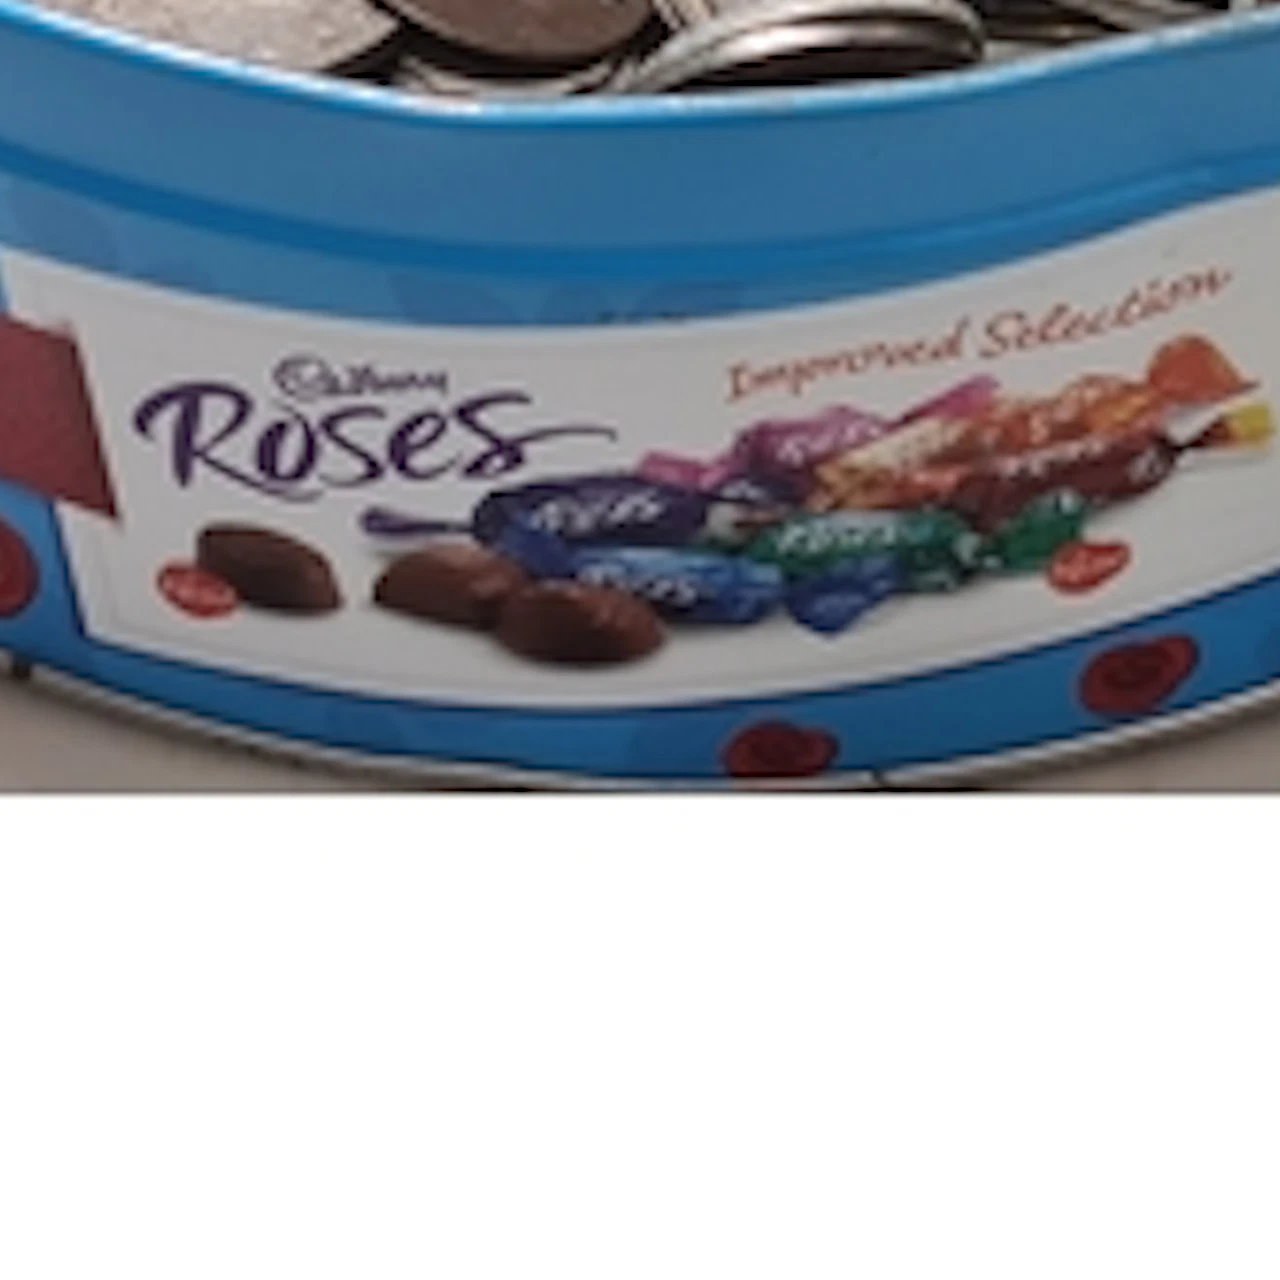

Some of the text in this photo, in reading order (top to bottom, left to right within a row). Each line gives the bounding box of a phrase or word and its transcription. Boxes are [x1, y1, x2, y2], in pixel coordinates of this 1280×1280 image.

[724, 266, 1232, 403] Improved Selection
[134, 382, 617, 503] Roses
